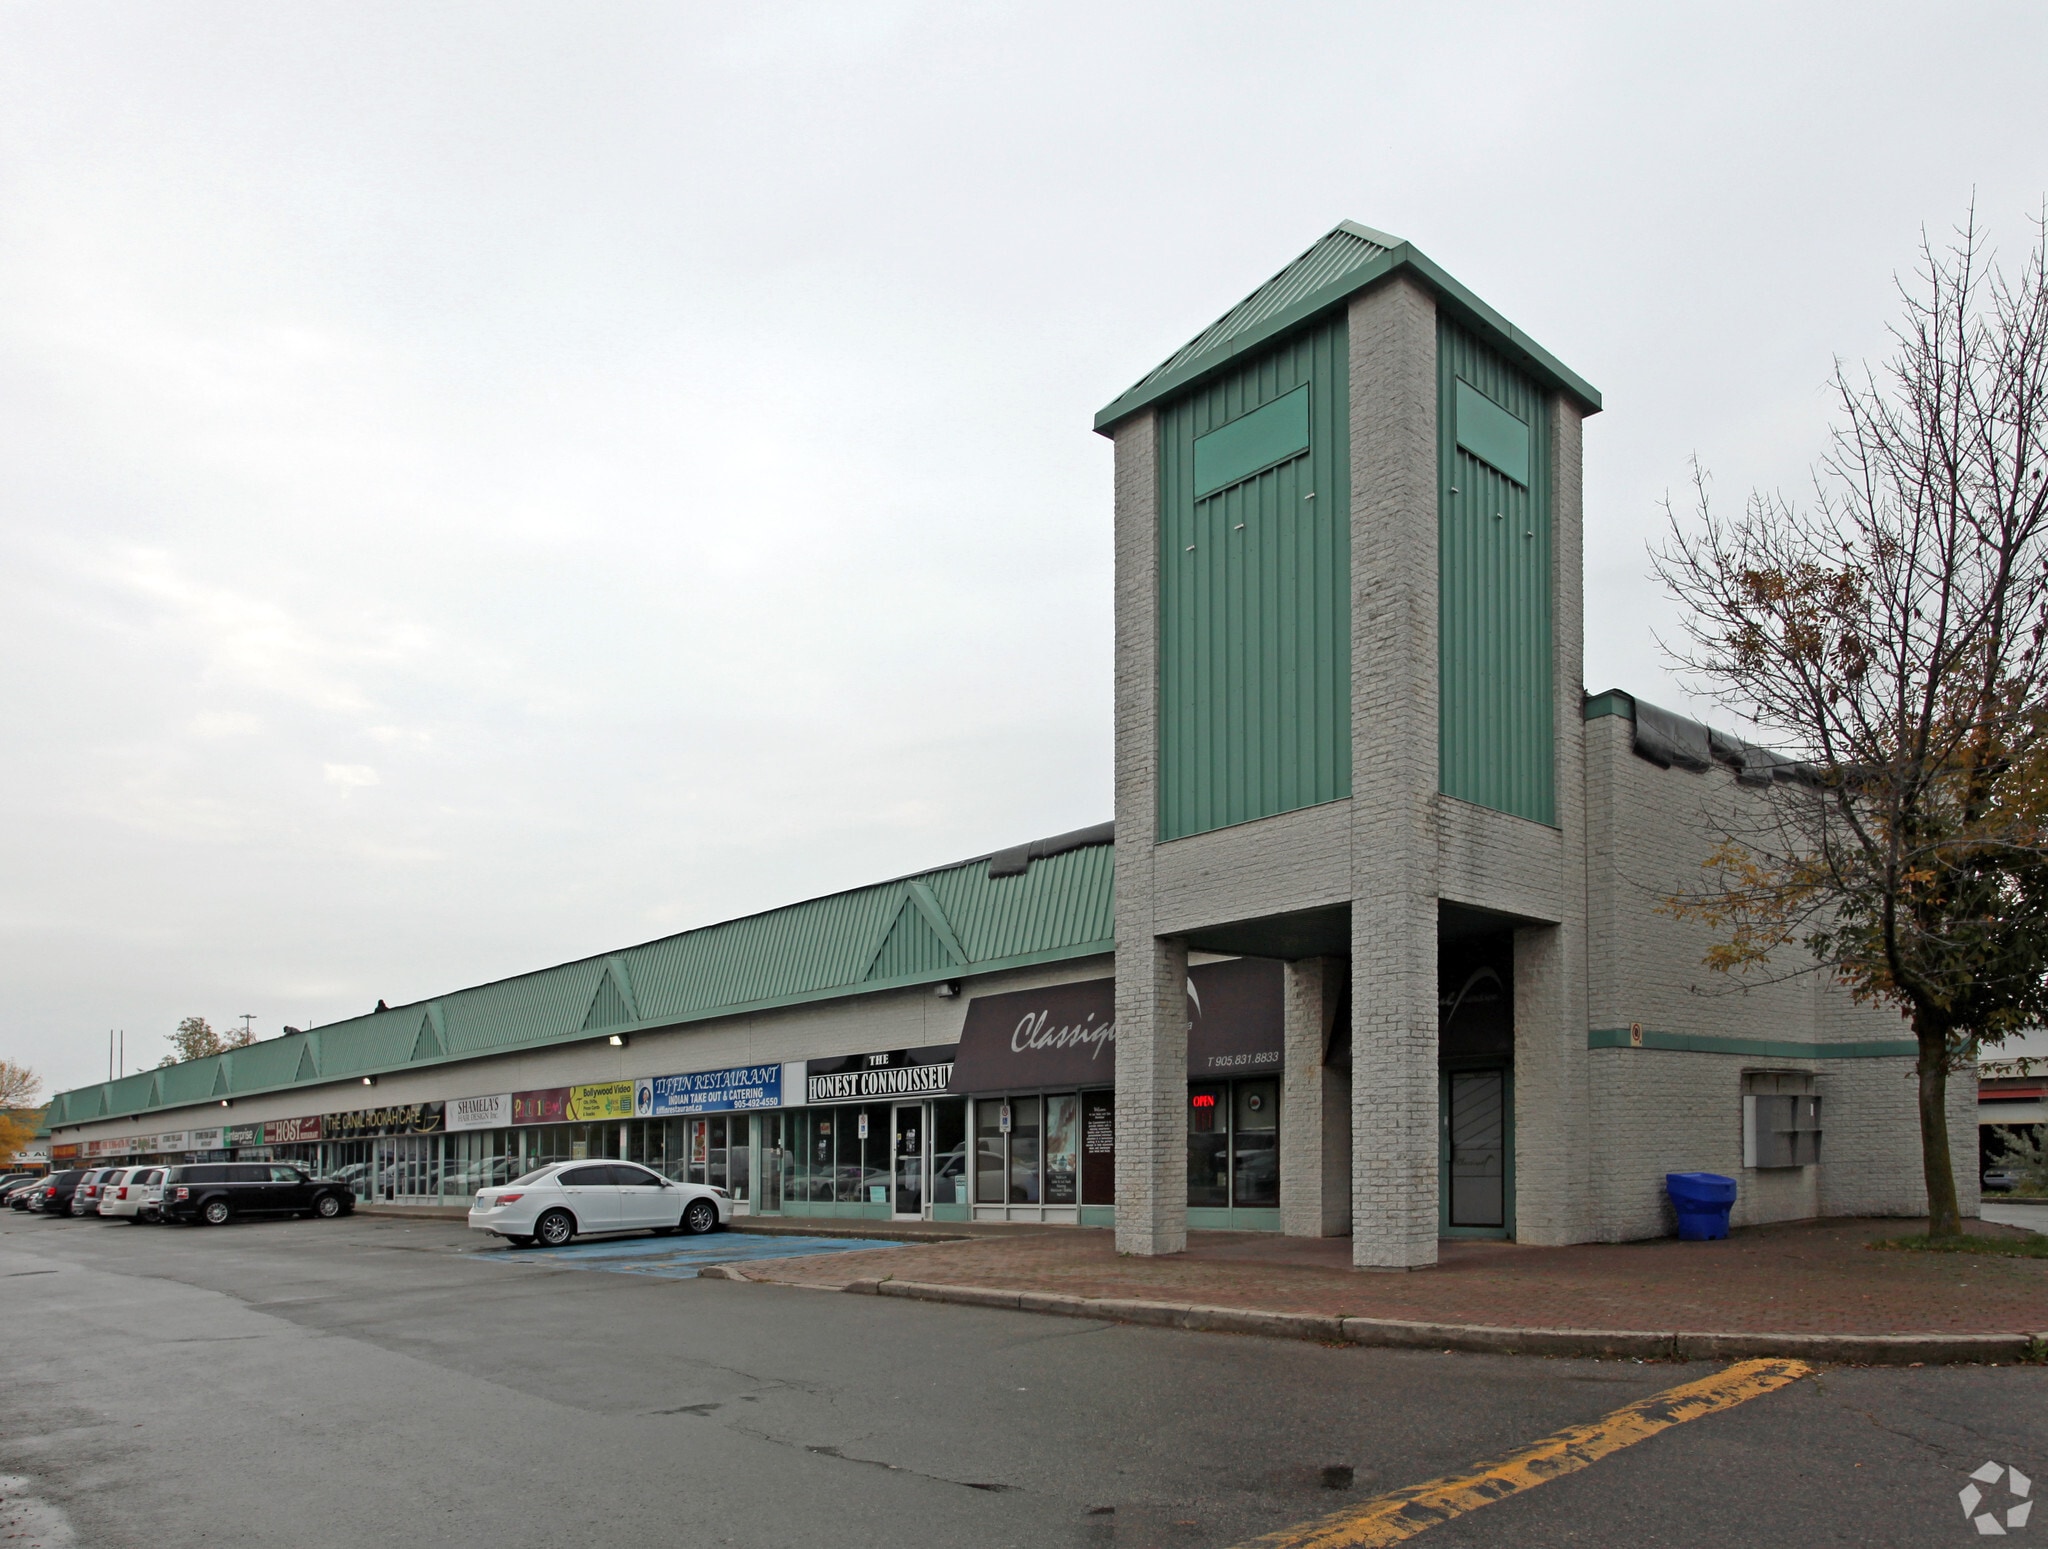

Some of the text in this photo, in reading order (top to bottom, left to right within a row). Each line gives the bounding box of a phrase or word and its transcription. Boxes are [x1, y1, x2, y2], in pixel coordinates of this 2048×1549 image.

[869, 1054, 889, 1066] THE
[1208, 1052, 1279, 1067] T 905.831.8833
[655, 1075, 693, 1096] TIFFIN
[695, 1065, 780, 1090] RESTAURANT
[808, 1074, 858, 1100] HONEST
[583, 1085, 613, 1098] Bollywood
[614, 1084, 631, 1094] Video
[668, 1087, 763, 1105] INDIAN TAKE OUT & CATERING
[458, 1097, 499, 1115] SHAMELA'S
[734, 1097, 778, 1108] 905-492-4550
[1193, 1095, 1215, 1107] OPEN
[457, 1113, 470, 1122] HAIR
[471, 1112, 489, 1121] DESIGN
[656, 1104, 703, 1115] tiffinrestaurant.ca
[327, 1108, 420, 1131] THE CANAL HOOKAH CAFE
[224, 1127, 254, 1144] enterprise
[275, 1119, 302, 1142] HOST
